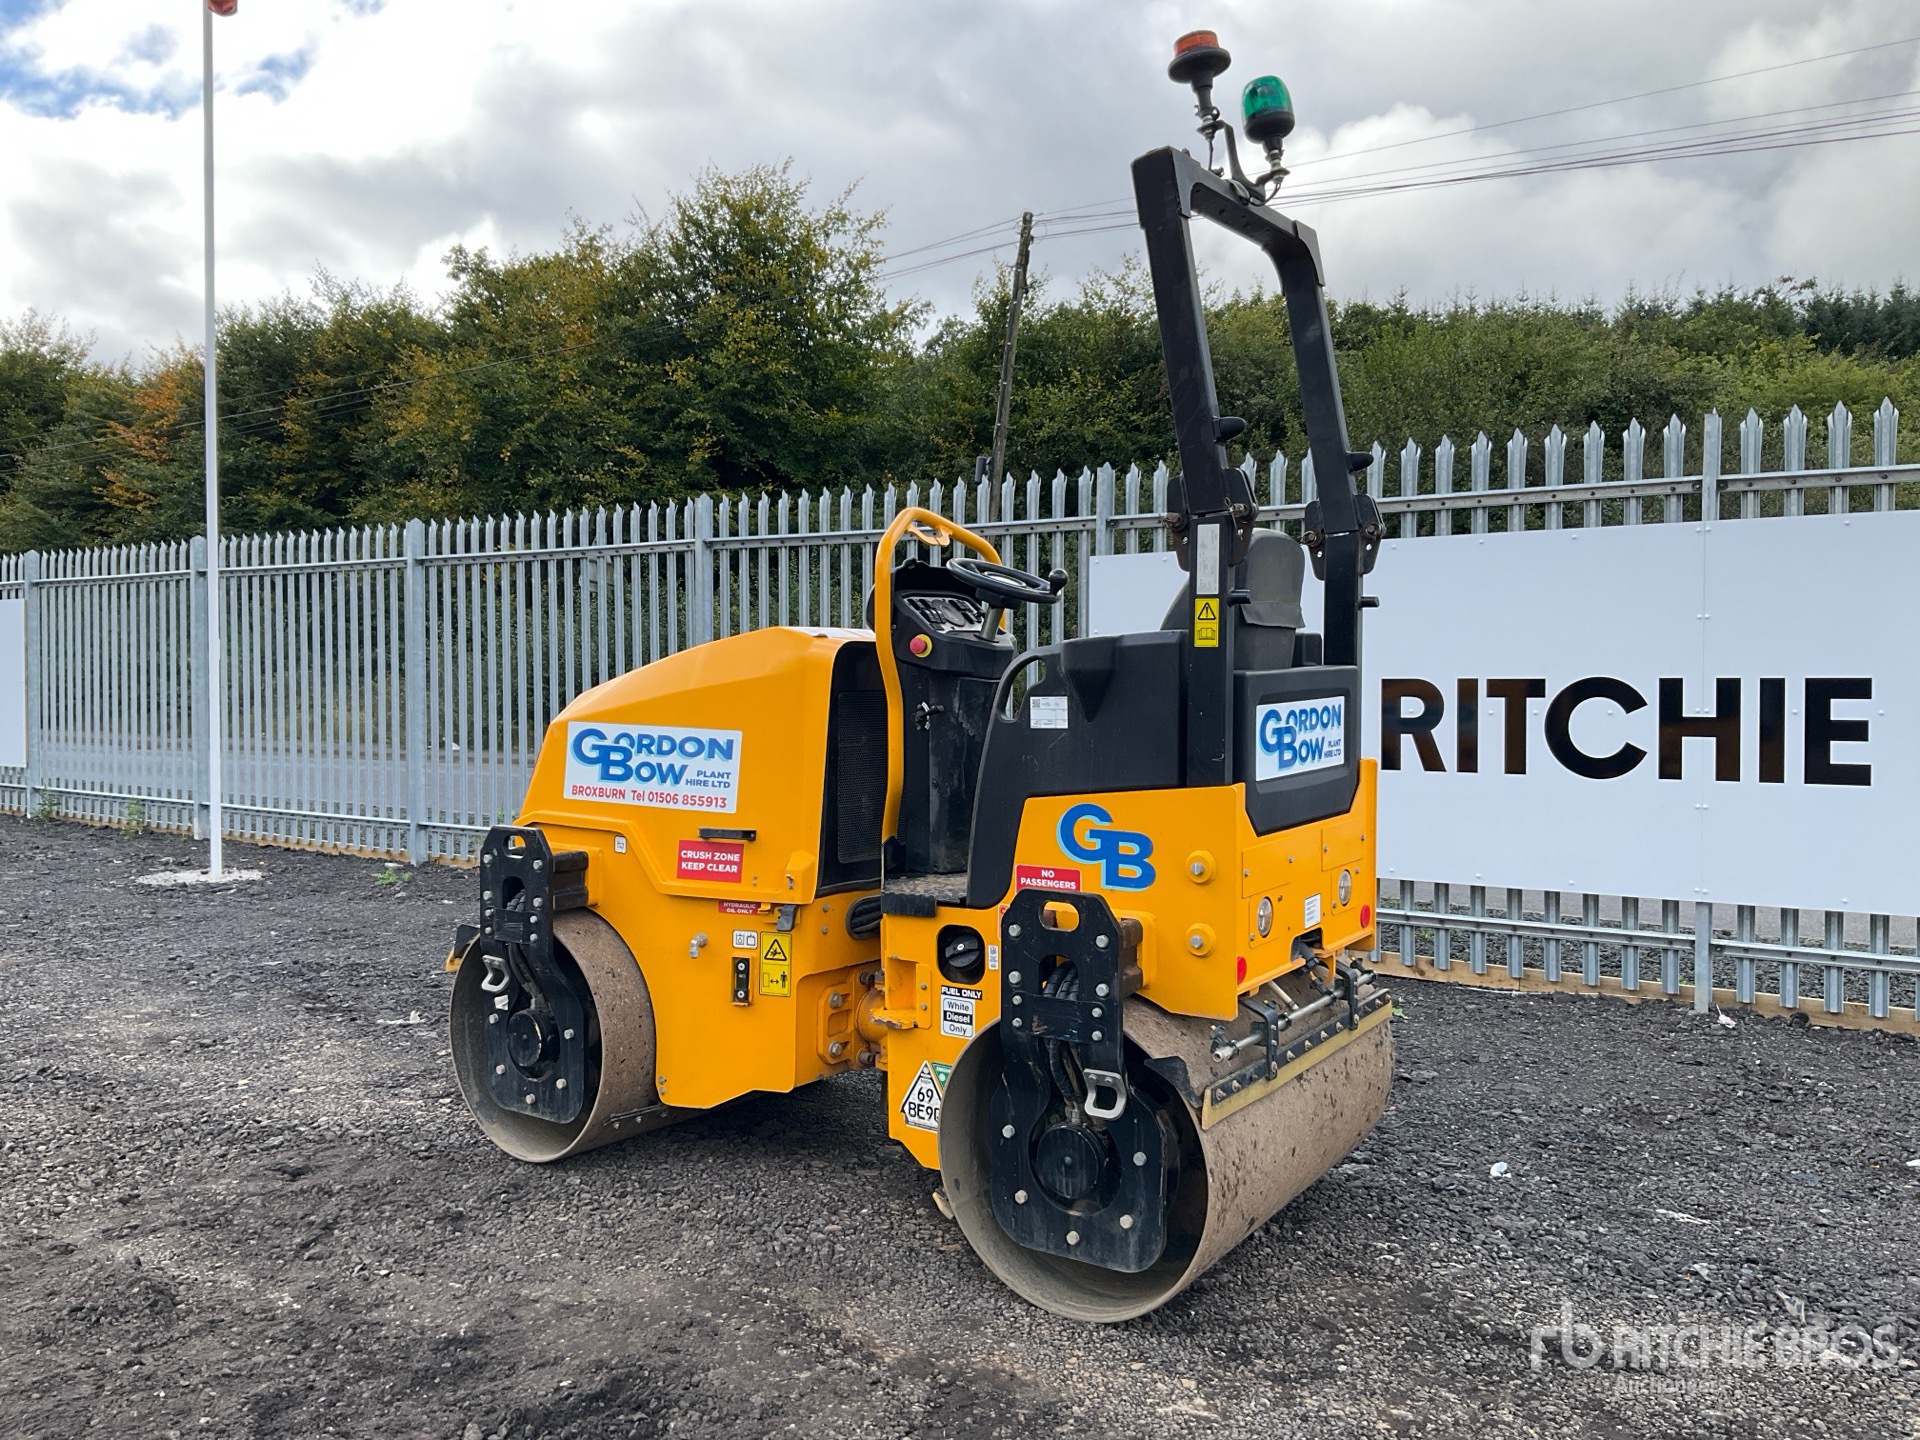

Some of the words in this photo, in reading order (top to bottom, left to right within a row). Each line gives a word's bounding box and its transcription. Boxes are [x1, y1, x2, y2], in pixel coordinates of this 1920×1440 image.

[1260, 704, 1342, 755] GORDON
[1381, 676, 1872, 787] RITCHIE
[572, 728, 734, 765] GORDON
[1278, 726, 1325, 771] BOW
[1328, 739, 1341, 748] PLANT
[599, 744, 689, 786] BOW
[697, 770, 731, 780] PLANT
[685, 778, 710, 788] HIRE
[711, 780, 731, 789] LTD
[571, 784, 626, 800] BROXBURN
[631, 789, 645, 802] Tel
[647, 792, 679, 805] 01506
[681, 795, 728, 809] 855913
[1057, 803, 1157, 892] GB
[681, 849, 712, 860] CRUSH
[713, 852, 741, 862] ZONE
[681, 861, 705, 871] KEEP
[706, 863, 738, 873] CLEAR
[1041, 869, 1055, 878] NO
[1020, 877, 1076, 890] PASSENGERS
[941, 986, 960, 996] FUEL
[961, 989, 982, 999] ONLY
[947, 1001, 970, 1012] White
[946, 1011, 970, 1024] Diesel
[949, 1023, 967, 1036] Only
[917, 1086, 934, 1103] 69
